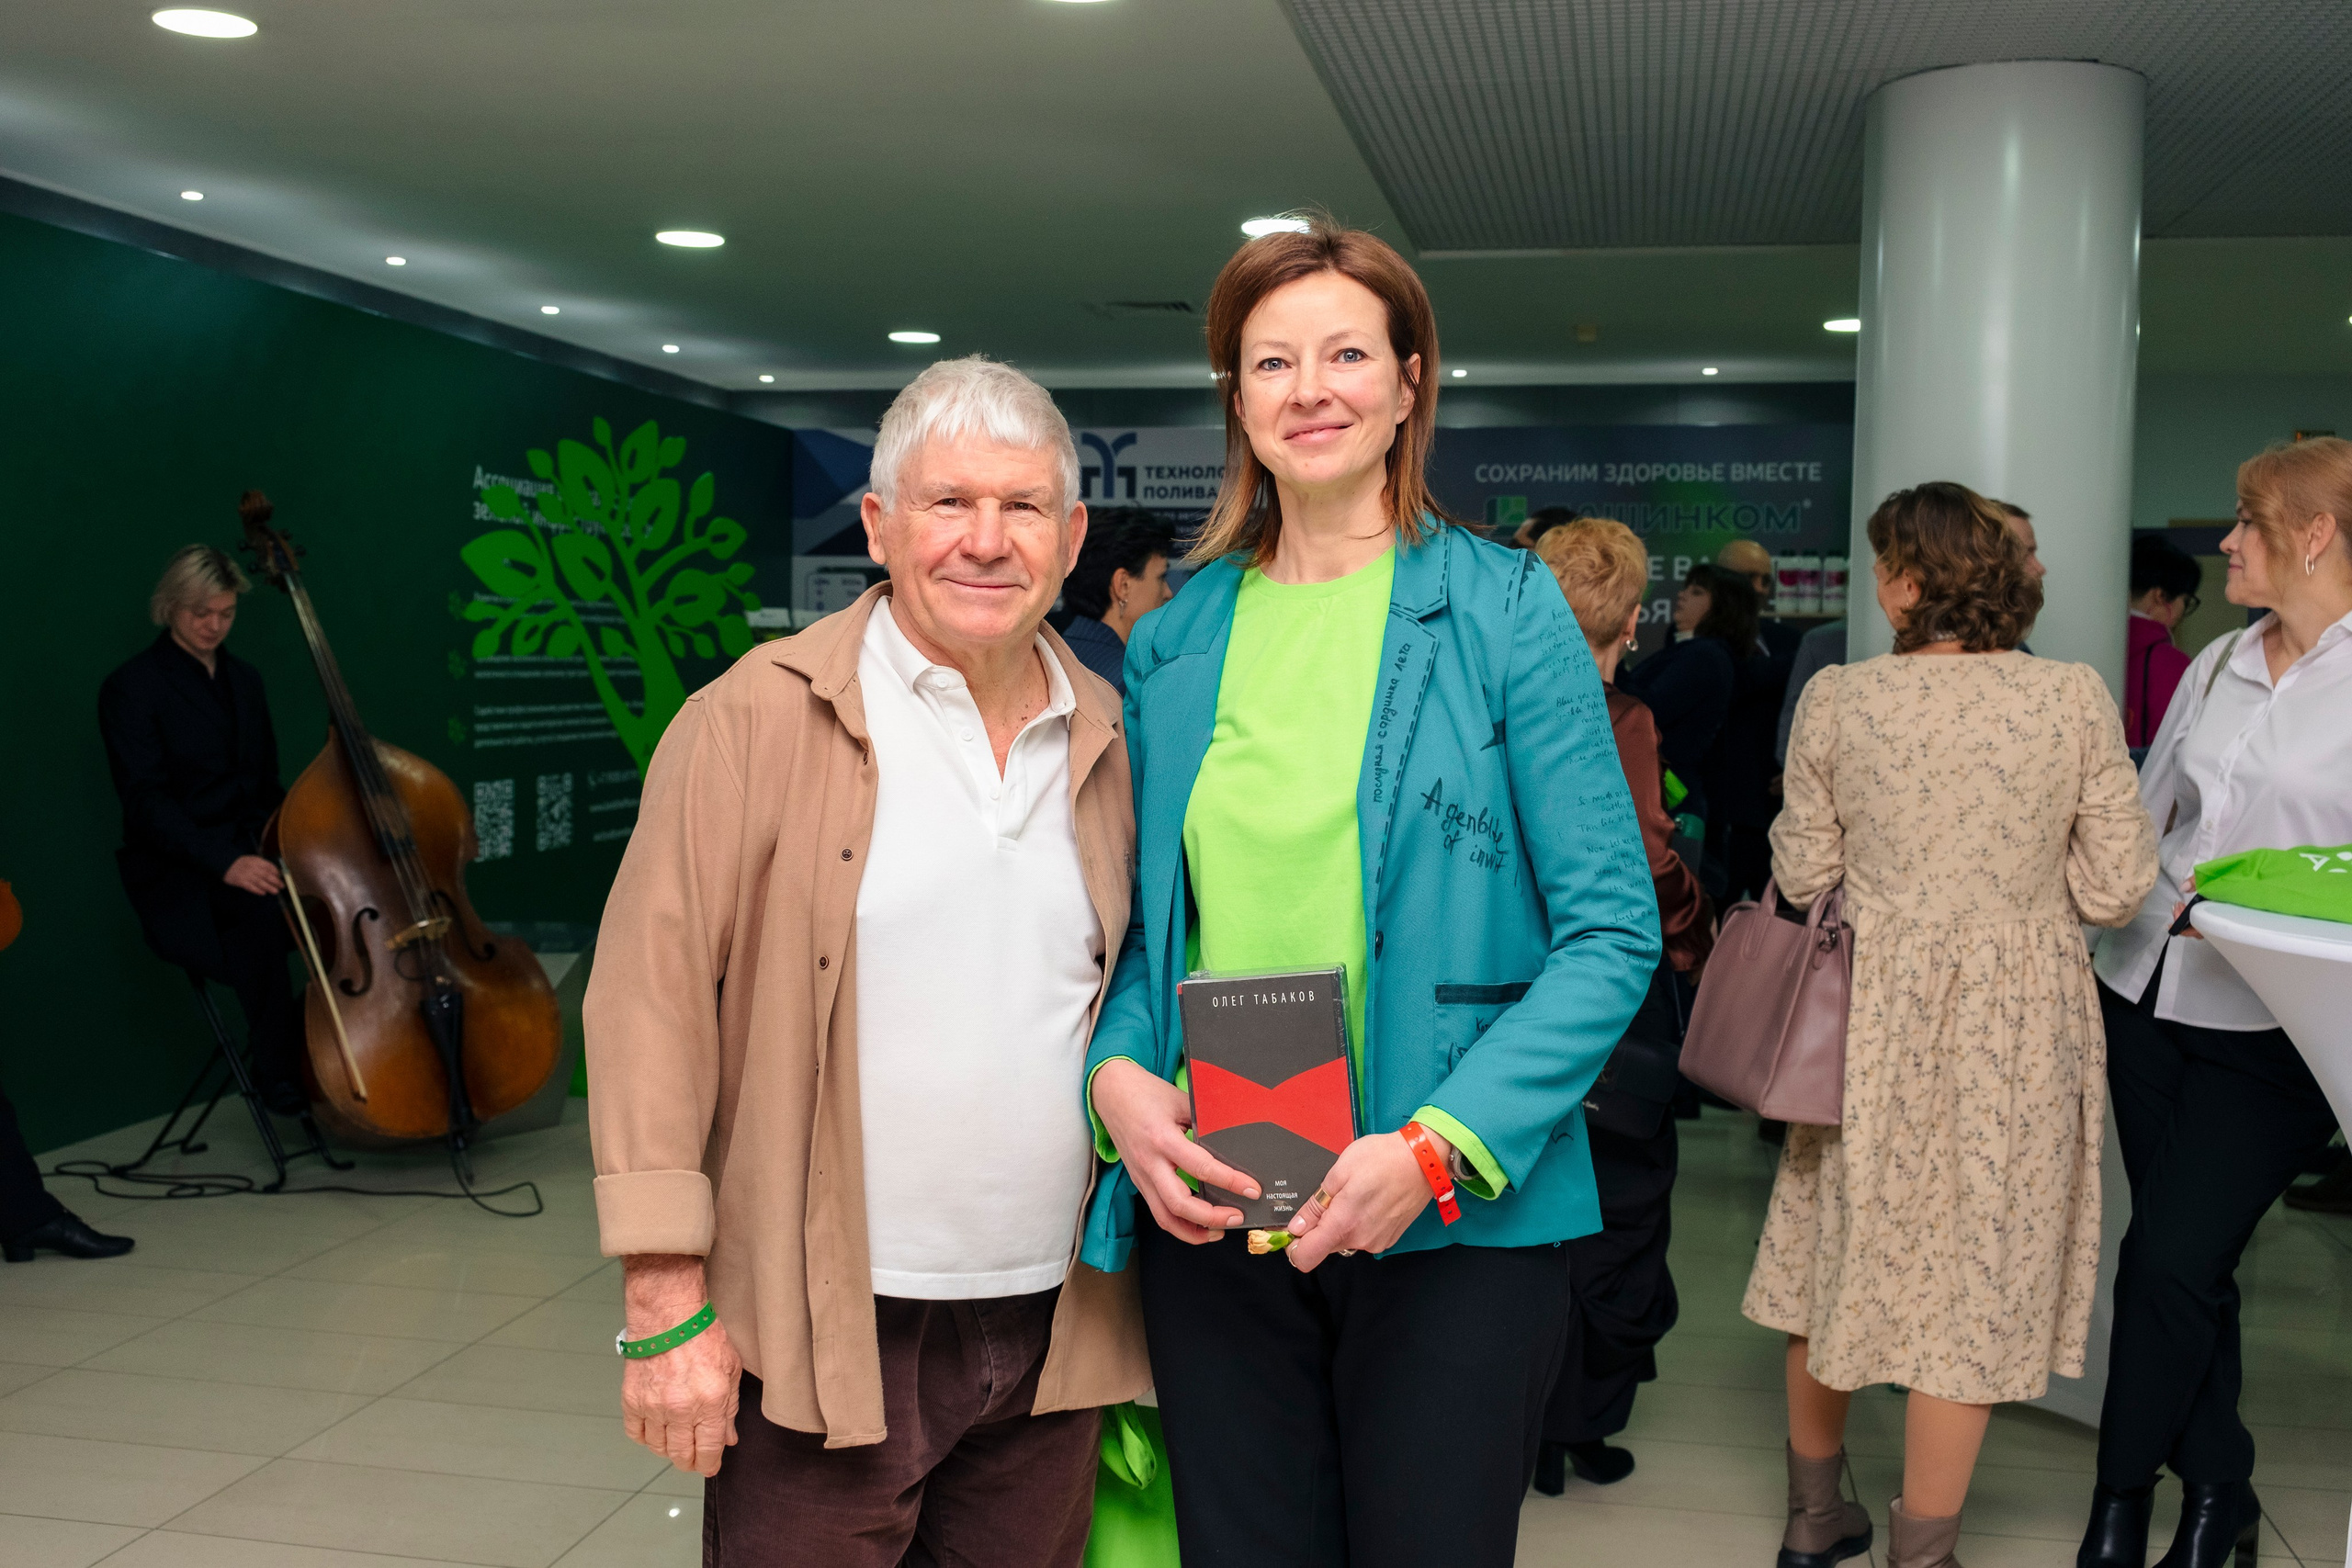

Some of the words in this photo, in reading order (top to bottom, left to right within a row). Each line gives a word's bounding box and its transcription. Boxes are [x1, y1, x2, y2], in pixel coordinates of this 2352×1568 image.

[1475, 463, 1599, 483] СОХРАНИМ
[1604, 462, 1725, 487] ЗДОРОВЬЕ
[1730, 461, 1823, 482] ВМЕСТЕ
[1394, 642, 1413, 672] лета
[1443, 829, 1464, 855] of
[1586, 846, 1606, 854] Now
[1213, 995, 1244, 1009] ОЛЕГ
[1253, 990, 1316, 1006] ТАБАКОВ
